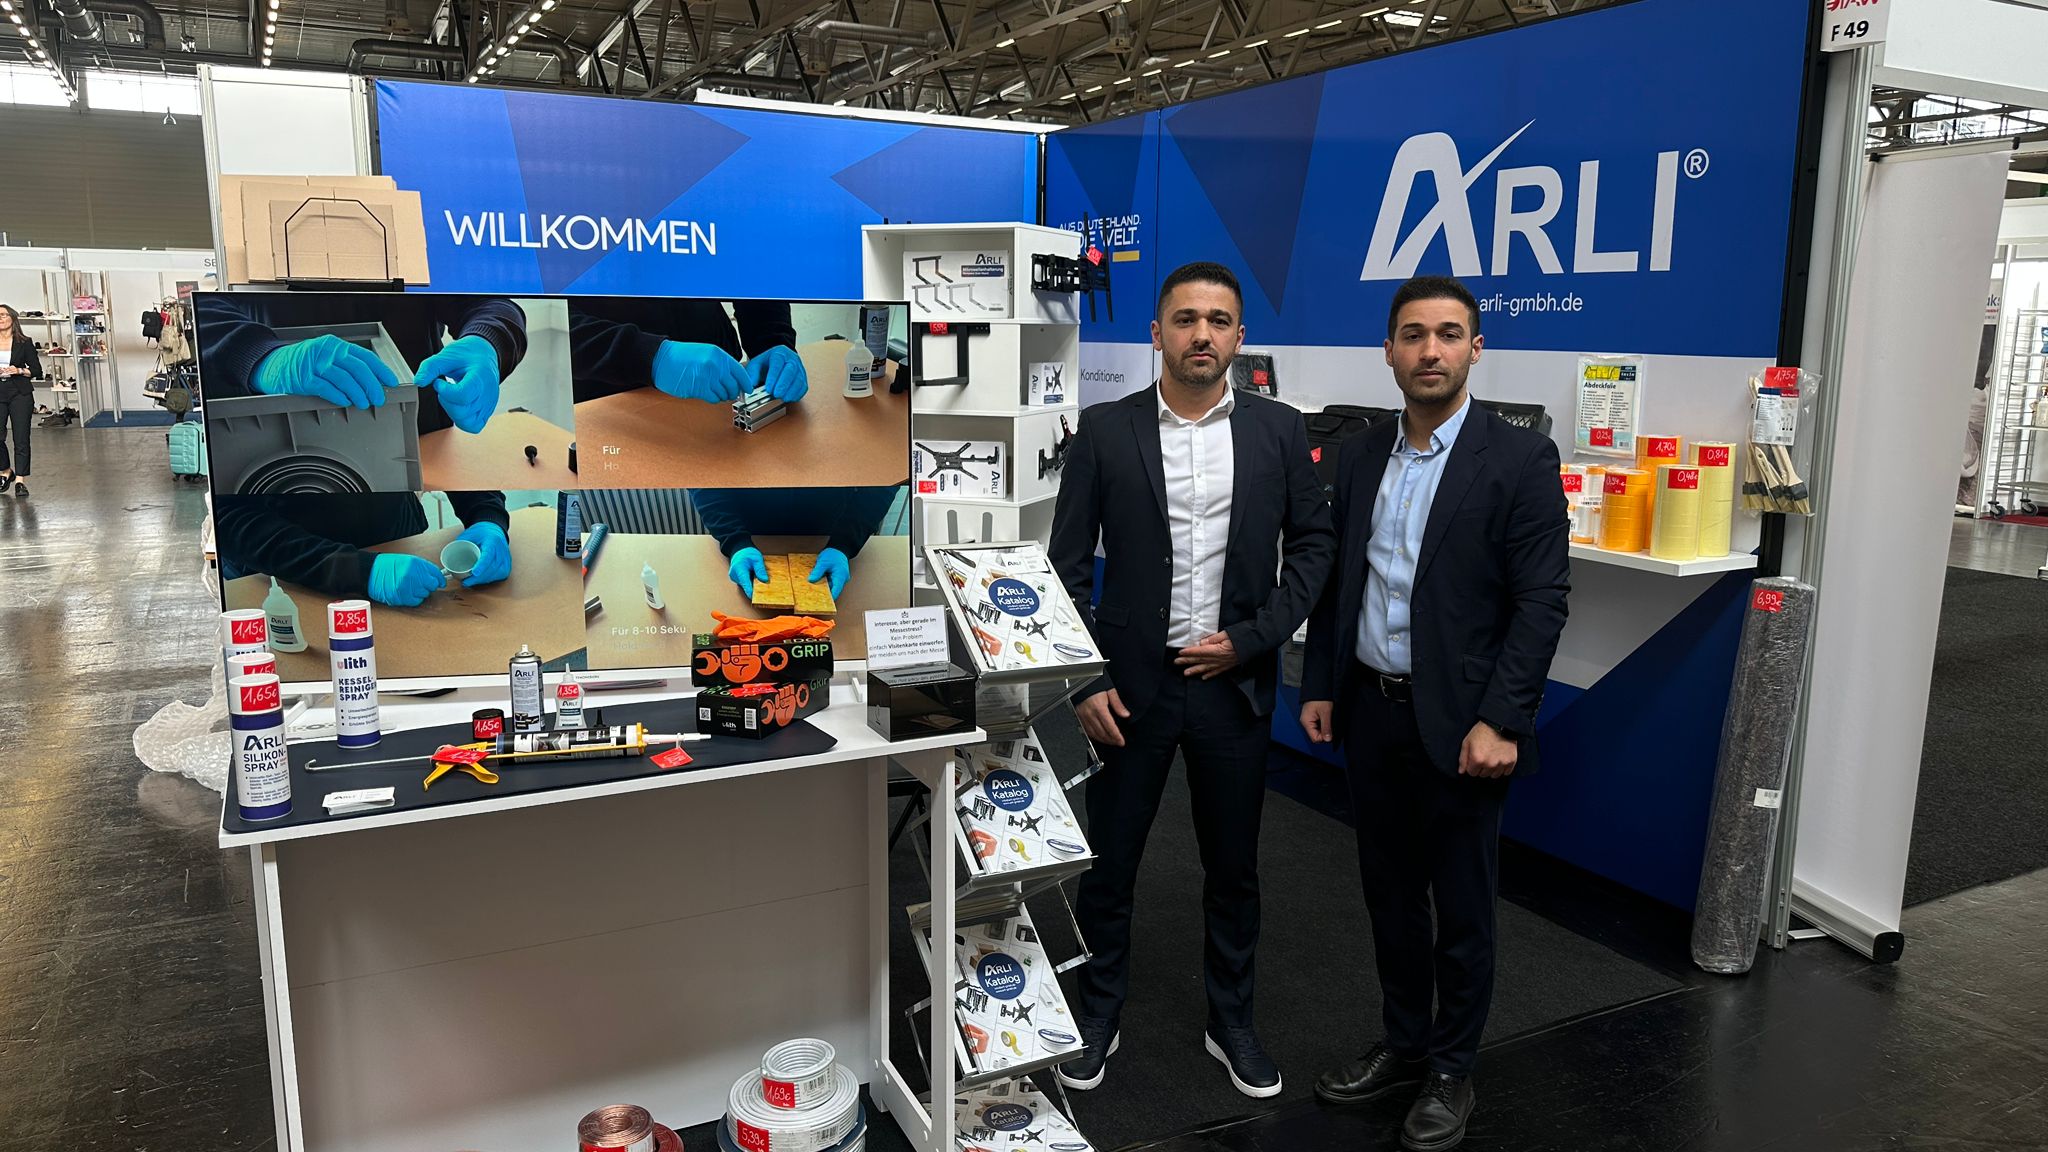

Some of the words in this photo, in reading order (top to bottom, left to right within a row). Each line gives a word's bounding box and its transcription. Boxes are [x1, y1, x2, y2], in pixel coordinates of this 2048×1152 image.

[1831, 25, 1841, 41] F
[1844, 20, 1869, 38] 49
[1078, 214, 1141, 231] DUTSCHLAND.
[444, 210, 717, 255] WILLKOMMEN
[975, 254, 1002, 264] ARLI
[1081, 369, 1125, 383] Konditionen
[602, 445, 621, 455] Für
[991, 470, 1001, 495] ARLI
[997, 586, 1026, 597] ARLI
[997, 596, 1035, 606] Katalog
[611, 627, 628, 636] Für
[632, 625, 657, 636] 8-10
[660, 624, 686, 635] Seku
[791, 643, 829, 658] GRIP
[888, 641, 918, 649] Visitenkarte
[337, 656, 368, 670] ulith
[515, 669, 535, 678] ARLI
[338, 676, 374, 686] KESSEL-
[339, 692, 370, 702] SPRAY
[243, 733, 285, 751] ARLI
[243, 748, 287, 763] SILIKON-
[244, 759, 279, 772] SPRAY
[992, 779, 1020, 790] ARLI
[992, 789, 1029, 799] Katalog
[984, 963, 1012, 977] ARLI
[985, 974, 1021, 988] Katalog
[991, 1114, 1028, 1126] Katalog
